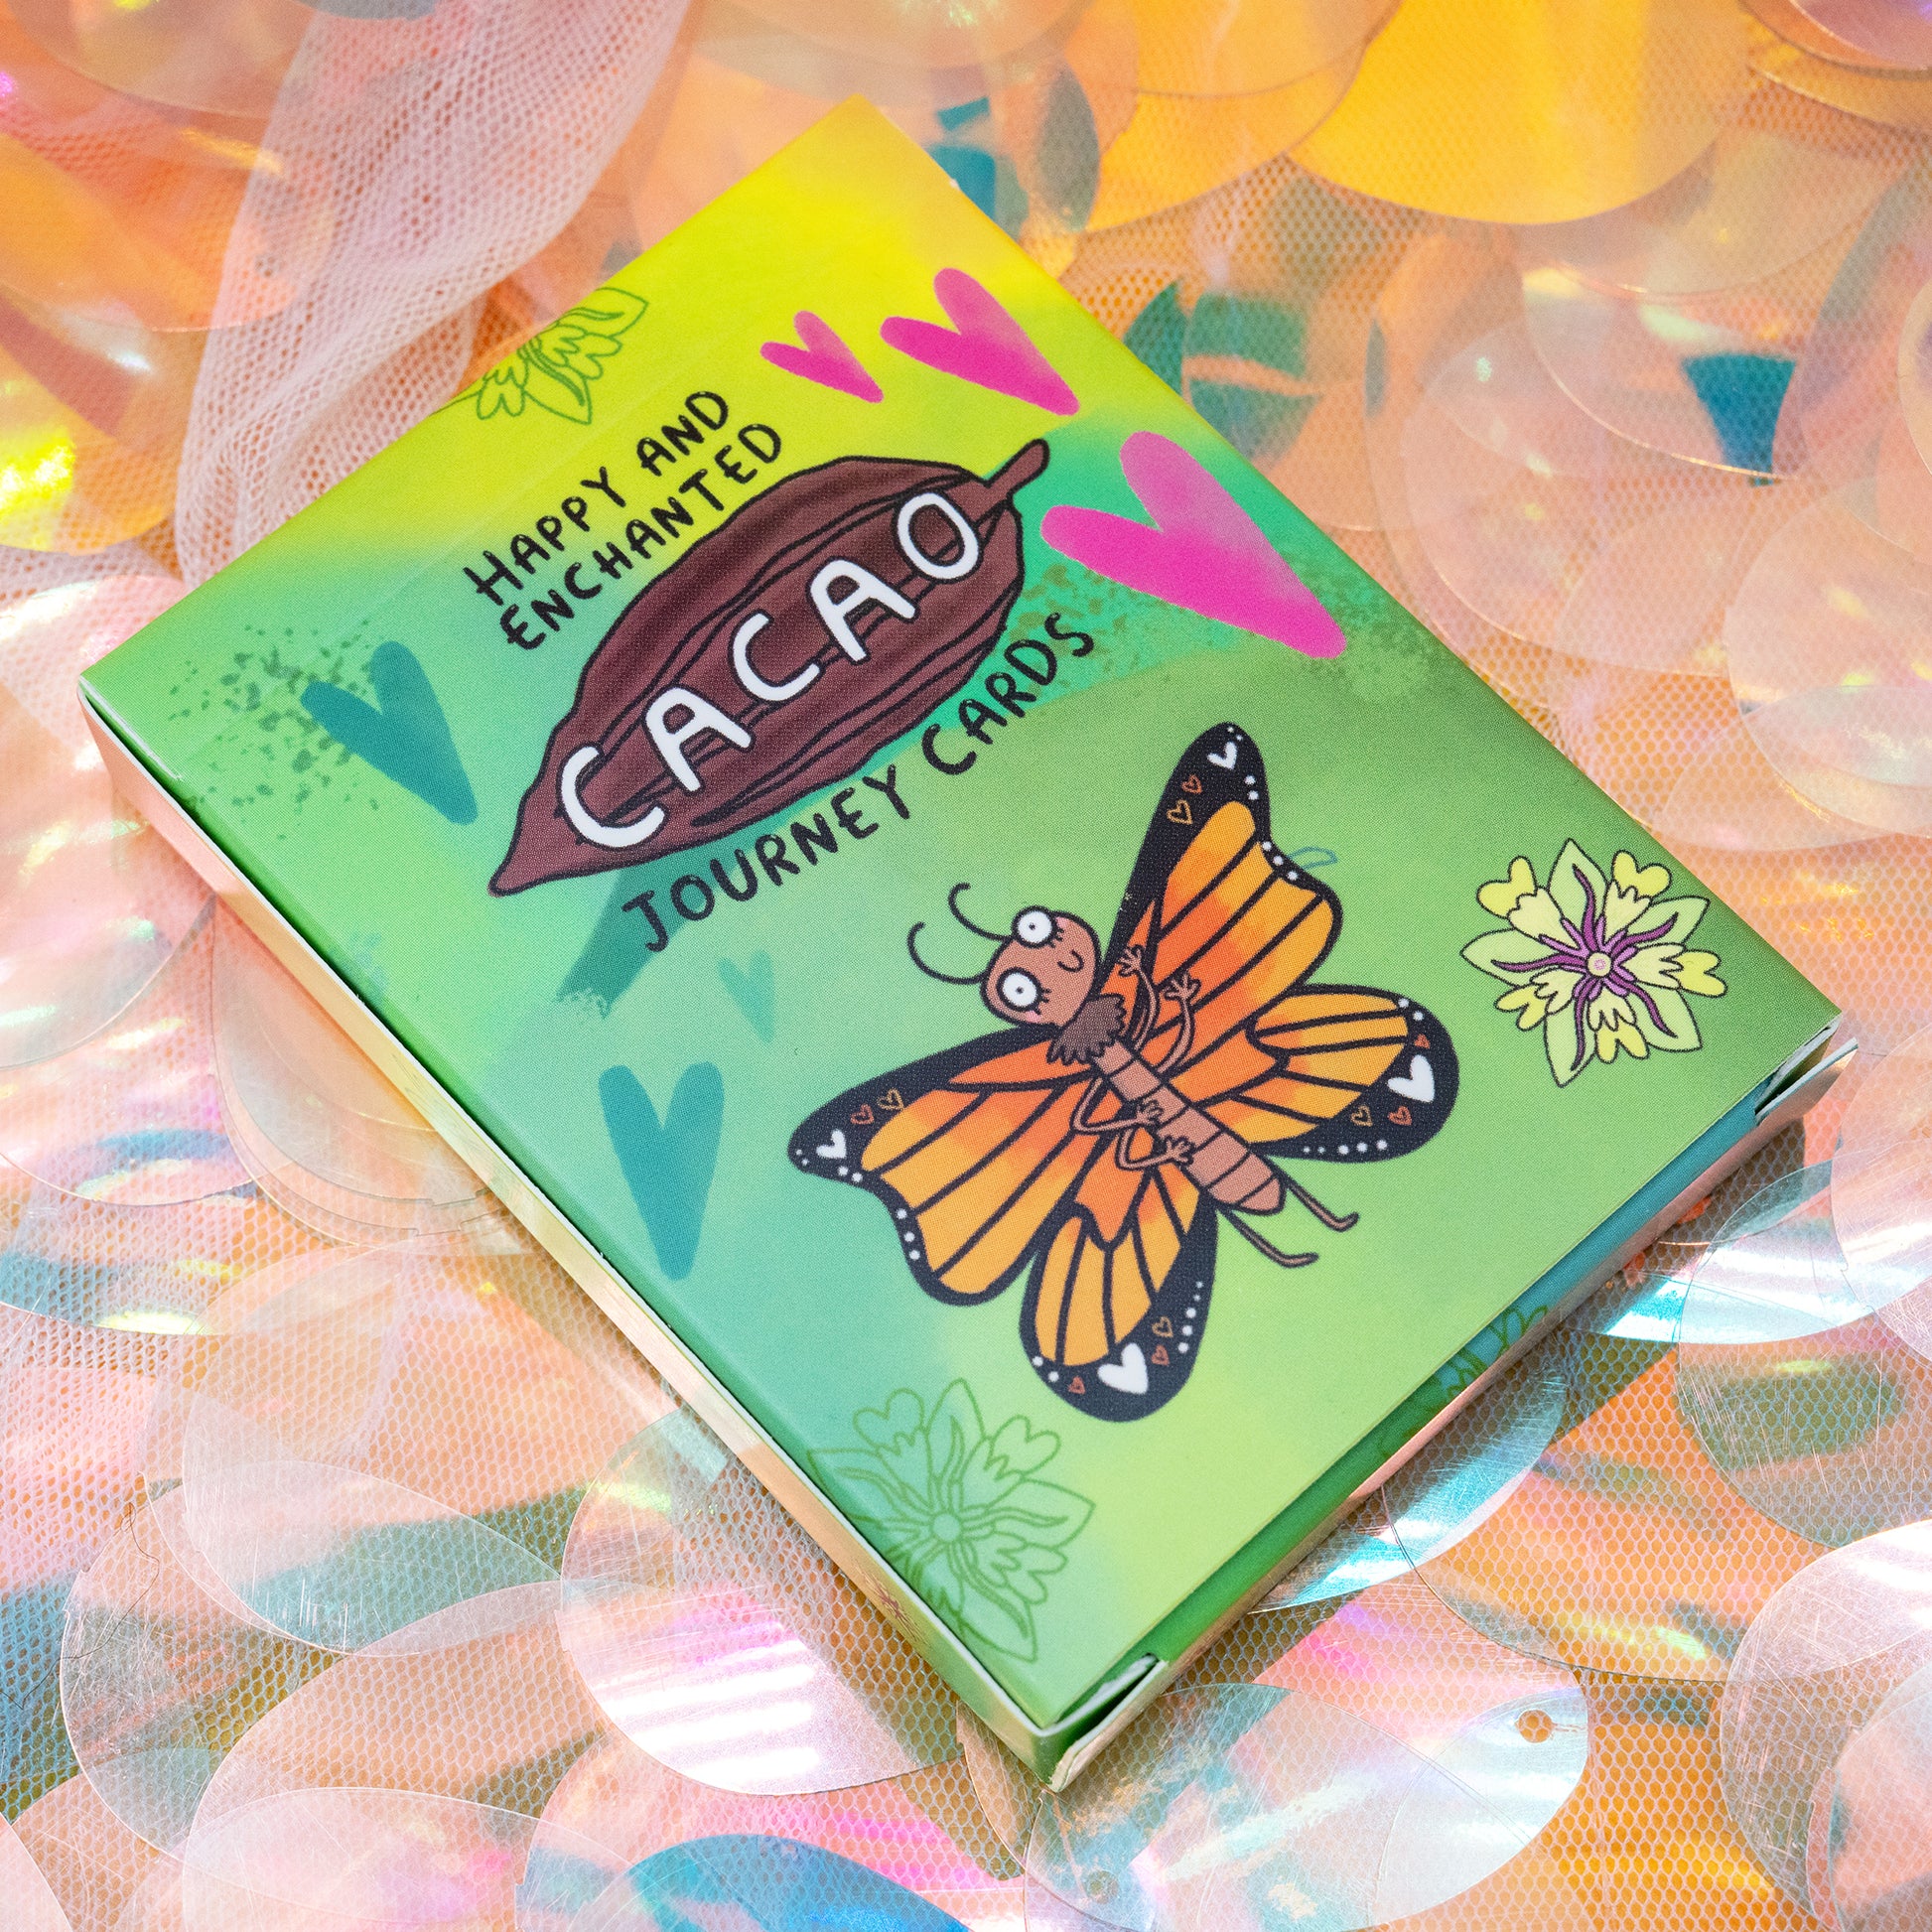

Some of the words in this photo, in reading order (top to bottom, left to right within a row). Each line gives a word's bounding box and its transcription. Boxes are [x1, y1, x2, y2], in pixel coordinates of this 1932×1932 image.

[463, 466, 626, 605] HAPPY
[635, 390, 730, 476] AND
[499, 423, 782, 650] ENCHANTED
[558, 490, 982, 851] CACAO
[621, 763, 910, 953] JOURNEY
[921, 613, 1095, 775] CARDS
